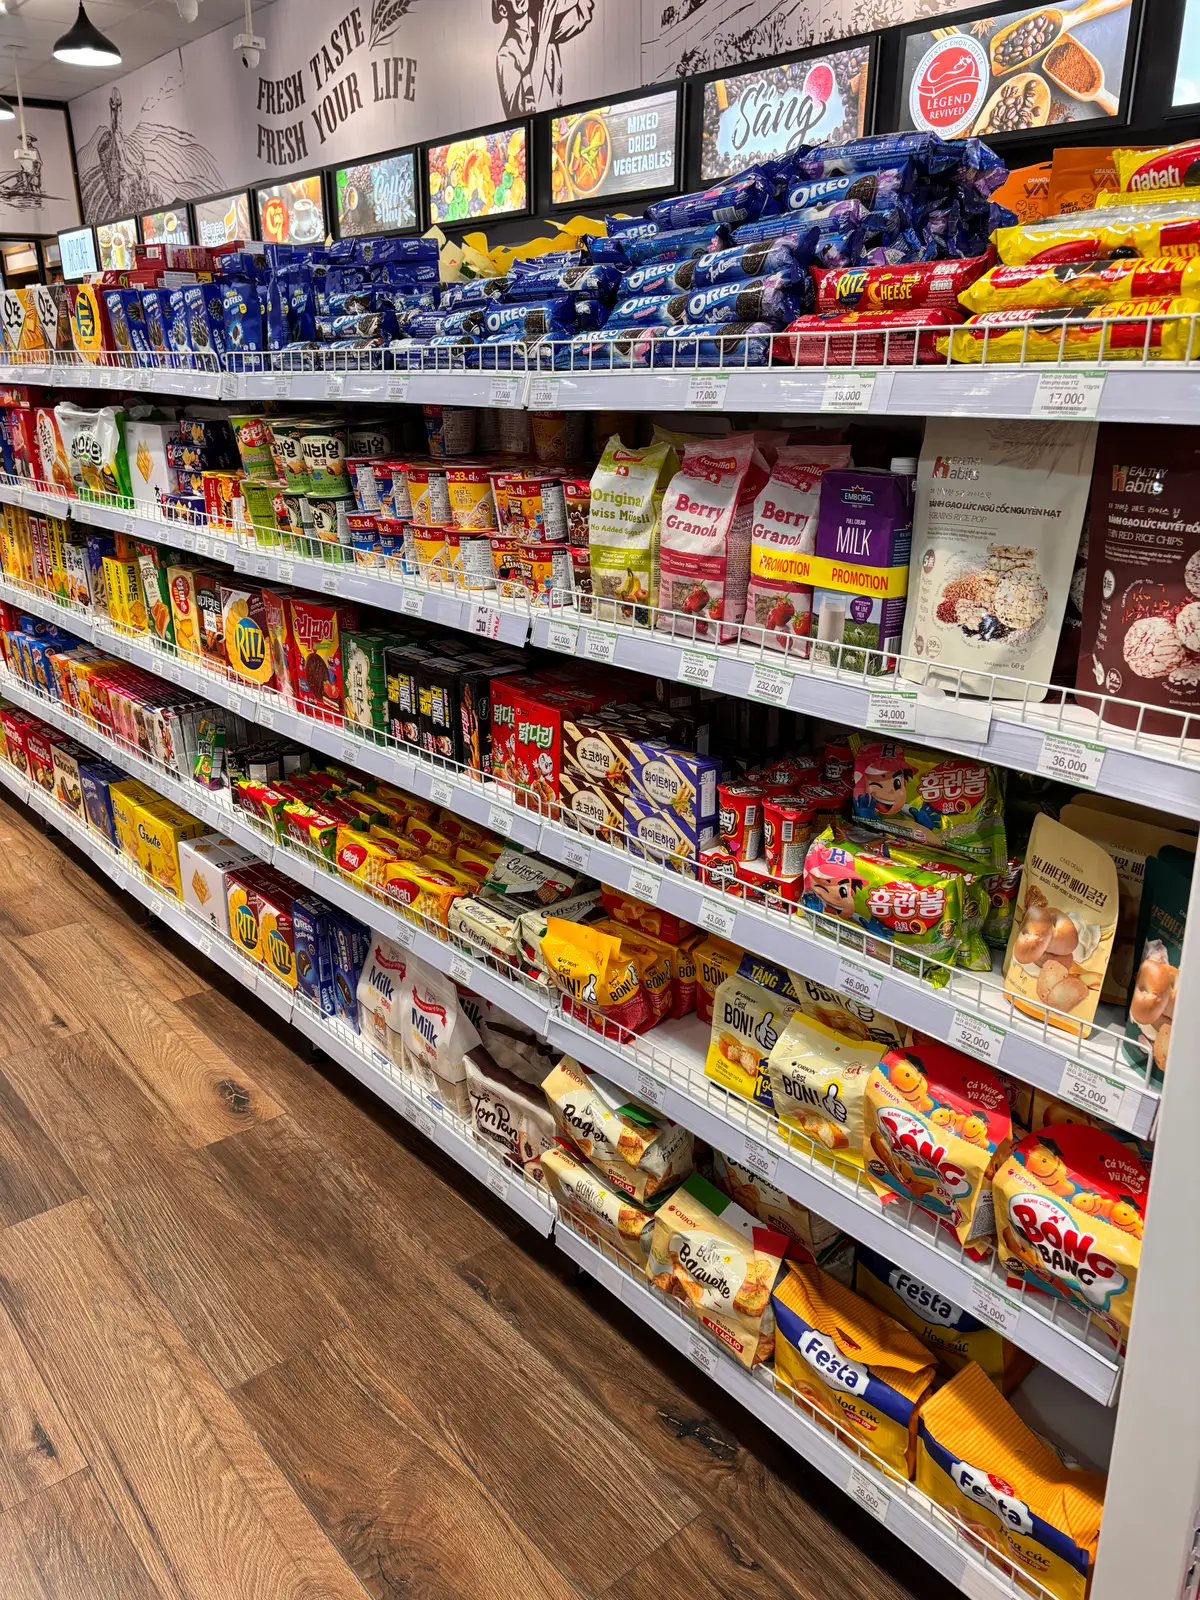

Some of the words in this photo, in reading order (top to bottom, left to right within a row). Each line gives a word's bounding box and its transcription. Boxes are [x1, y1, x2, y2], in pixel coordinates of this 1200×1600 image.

[257, 70, 306, 115] FRESH
[309, 7, 365, 91] TASTE
[257, 120, 309, 165] FRESH
[311, 72, 363, 145] YOUR
[371, 57, 418, 102] LIFE
[927, 93, 971, 110] LEGEND
[627, 111, 659, 134] MIXED
[930, 107, 965, 120] REVIVED
[628, 133, 657, 155] DRIED
[613, 150, 672, 177] VEGETABLES
[1131, 164, 1180, 192] nabati
[373, 174, 412, 209] Coffee
[789, 177, 850, 210] OREO
[626, 262, 676, 290] OREO
[836, 271, 870, 299] RITZ
[106, 294, 120, 307] OREO
[142, 294, 157, 307] OREO
[169, 291, 183, 304] OREO
[184, 289, 201, 304] OREO
[223, 294, 244, 311] OREO
[689, 282, 741, 316] OREO
[868, 280, 913, 305] CHEESE
[487, 306, 527, 332] OREO
[695, 390, 718, 401] 17,000
[833, 390, 861, 402] 19,000
[1049, 393, 1085, 406] 17,000
[592, 487, 645, 508] Original
[844, 492, 871, 502] EMBORG
[619, 509, 650, 524] Müesli
[675, 493, 726, 523] Berry
[1043, 509, 1062, 519] HẠT
[590, 523, 600, 531] No
[601, 524, 623, 534] Added
[666, 514, 717, 538] Granola
[1122, 518, 1139, 528] GẠO
[1157, 519, 1185, 532] HUYẾT
[836, 525, 873, 557] MILK
[1118, 530, 1134, 541] RED
[1135, 532, 1155, 543] RICE
[1156, 535, 1184, 547] CHIPS
[759, 554, 811, 578] PROMOTION
[831, 567, 889, 591] PROMOTION
[236, 625, 265, 660] RITZ
[589, 643, 610, 655] 174,000
[684, 665, 709, 679] 222,000
[1011, 661, 1020, 670] 60
[756, 680, 784, 696] 232,000
[879, 709, 906, 720] 34,000
[518, 721, 554, 749] 닭다리
[1052, 755, 1087, 773] 36,000
[644, 770, 678, 795] 화이트하임
[919, 769, 988, 800] 홈런볼
[566, 850, 584, 863] 31,000
[828, 847, 847, 865] H
[507, 857, 533, 879] Coffee
[386, 883, 411, 904] nabati
[634, 881, 654, 895] 30,000
[868, 889, 946, 919] 홈런볼
[235, 910, 259, 942] RITZ
[293, 919, 314, 932] OREO
[706, 913, 727, 929] 43,000
[268, 936, 292, 968] RITZ
[368, 965, 394, 1002] Milk
[609, 978, 635, 1002] BON!
[843, 976, 870, 996] 46,000
[734, 996, 747, 1010] C'est
[411, 1006, 437, 1048] Milk
[724, 1002, 754, 1038] BON!
[960, 1030, 990, 1050] 52,000
[564, 1068, 587, 1087] ORION
[791, 1068, 807, 1083] C'est
[797, 1062, 817, 1076] ORION
[782, 1074, 823, 1108] BON!
[967, 1080, 979, 1090] Cá
[1073, 1082, 1107, 1105] 52,000
[880, 1086, 903, 1105] ORION
[558, 1152, 578, 1169] ORION
[748, 1153, 769, 1171] 22,000
[1105, 1159, 1117, 1169] Cá
[1014, 1173, 1039, 1190] ORION
[1108, 1171, 1121, 1181] Vũ
[1121, 1173, 1142, 1189] Môn
[675, 1208, 700, 1230] ORION
[679, 1241, 731, 1300] Baguette
[1039, 1245, 1097, 1287] BANG
[977, 1300, 1006, 1324] 34,000
[706, 1321, 742, 1352] ALL'AGLIO
[716, 1319, 737, 1338] BURRO
[922, 1326, 948, 1346] Hoa
[948, 1339, 969, 1354] cúc
[1024, 1549, 1051, 1568] cúc
